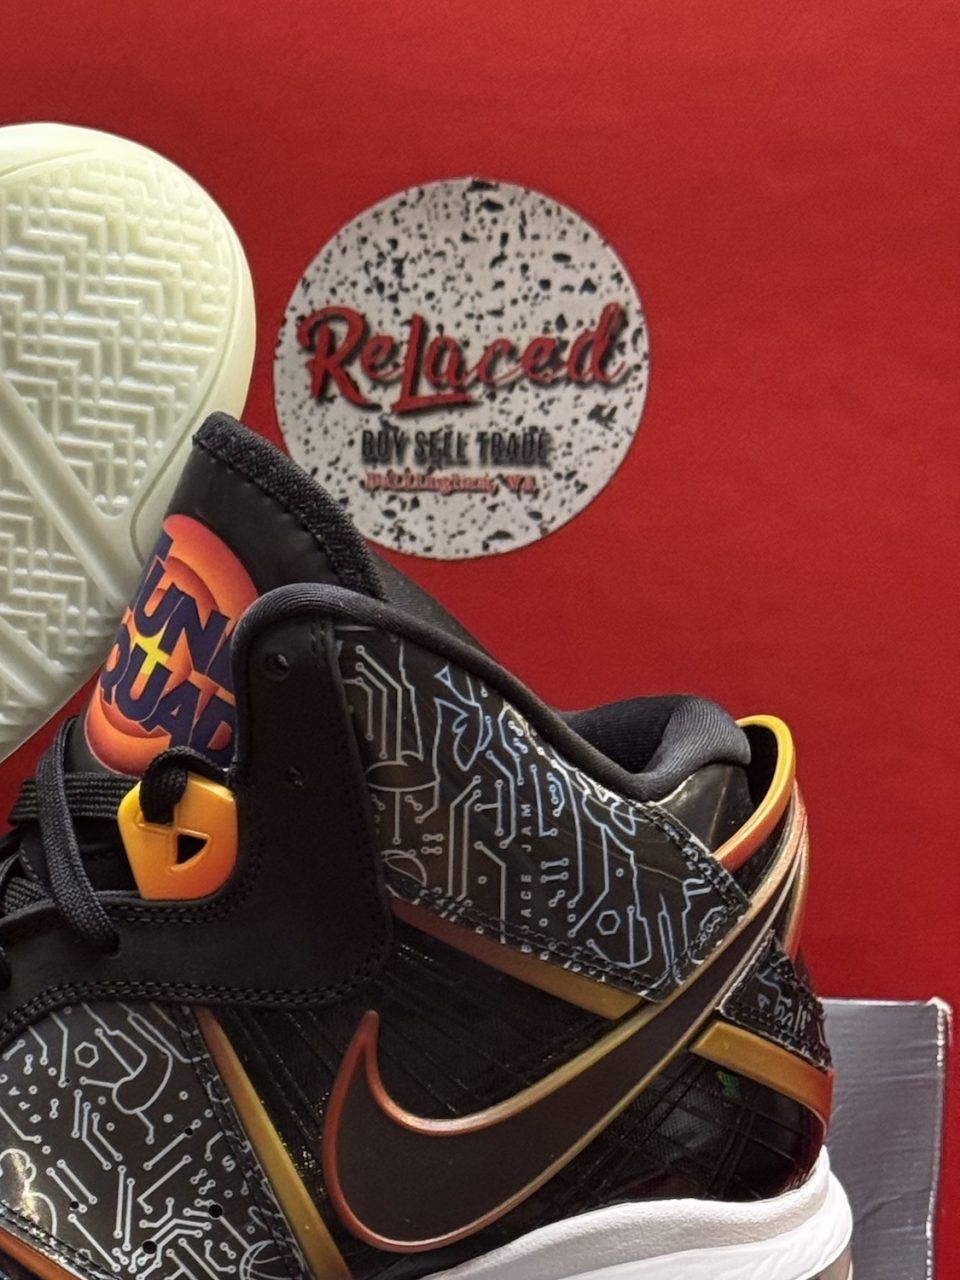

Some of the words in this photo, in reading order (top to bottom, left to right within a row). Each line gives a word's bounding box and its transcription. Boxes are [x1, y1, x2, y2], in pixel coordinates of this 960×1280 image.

[297, 302, 628, 415] ReLaced
[362, 430, 407, 465] BUY
[414, 430, 470, 467] SELL
[476, 430, 553, 468] TRADE
[130, 531, 237, 697] UN
[99, 622, 238, 769] QUAD
[520, 803, 533, 853] JAM
